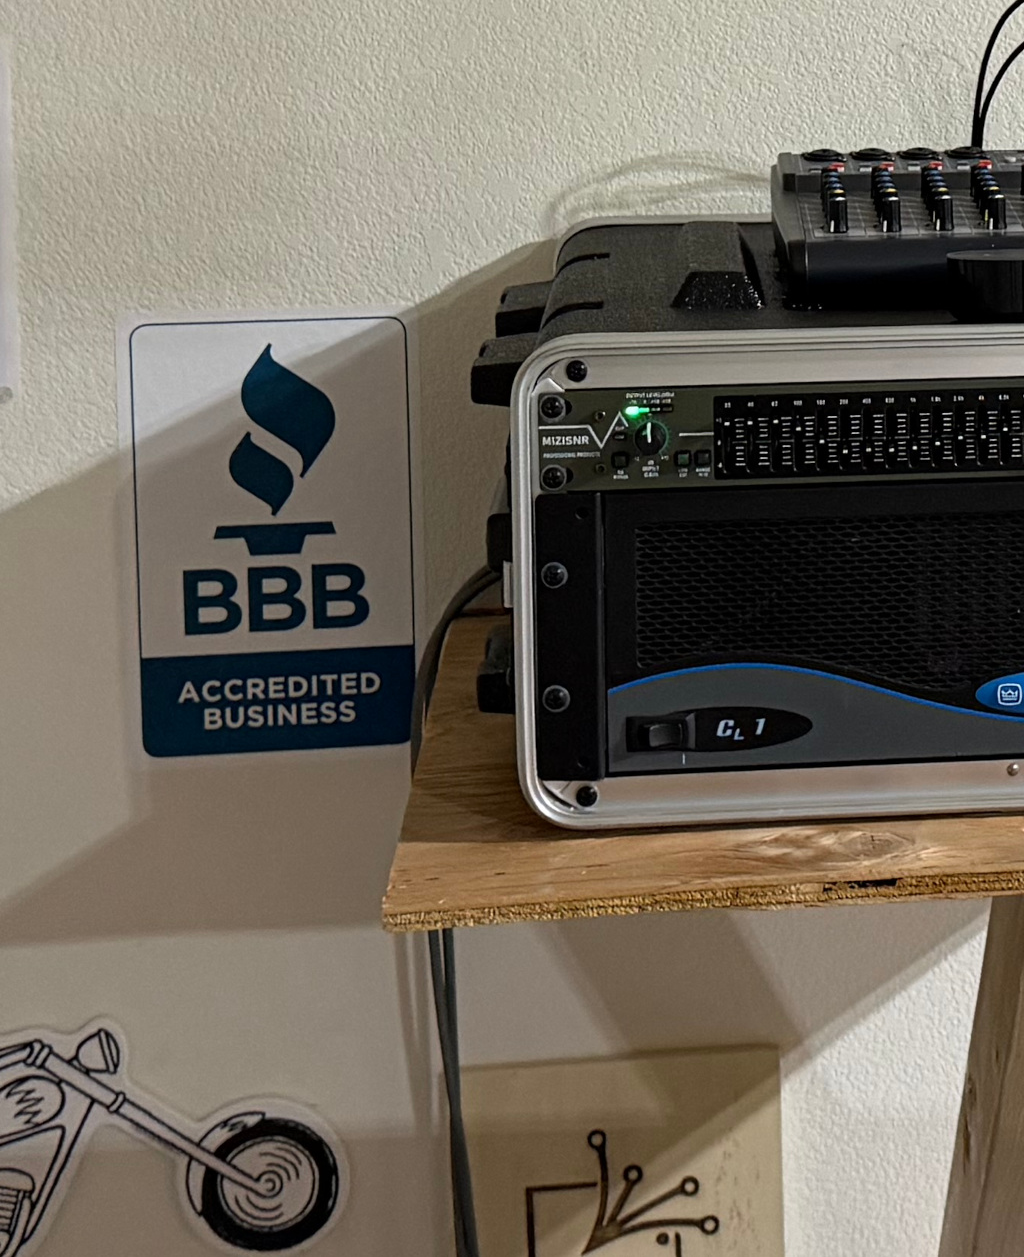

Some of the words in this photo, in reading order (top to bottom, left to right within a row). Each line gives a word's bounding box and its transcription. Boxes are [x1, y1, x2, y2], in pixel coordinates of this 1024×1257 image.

[182, 562, 370, 636] BBB
[178, 672, 381, 704] ACCREDITED
[203, 700, 357, 731] BUSINESS
